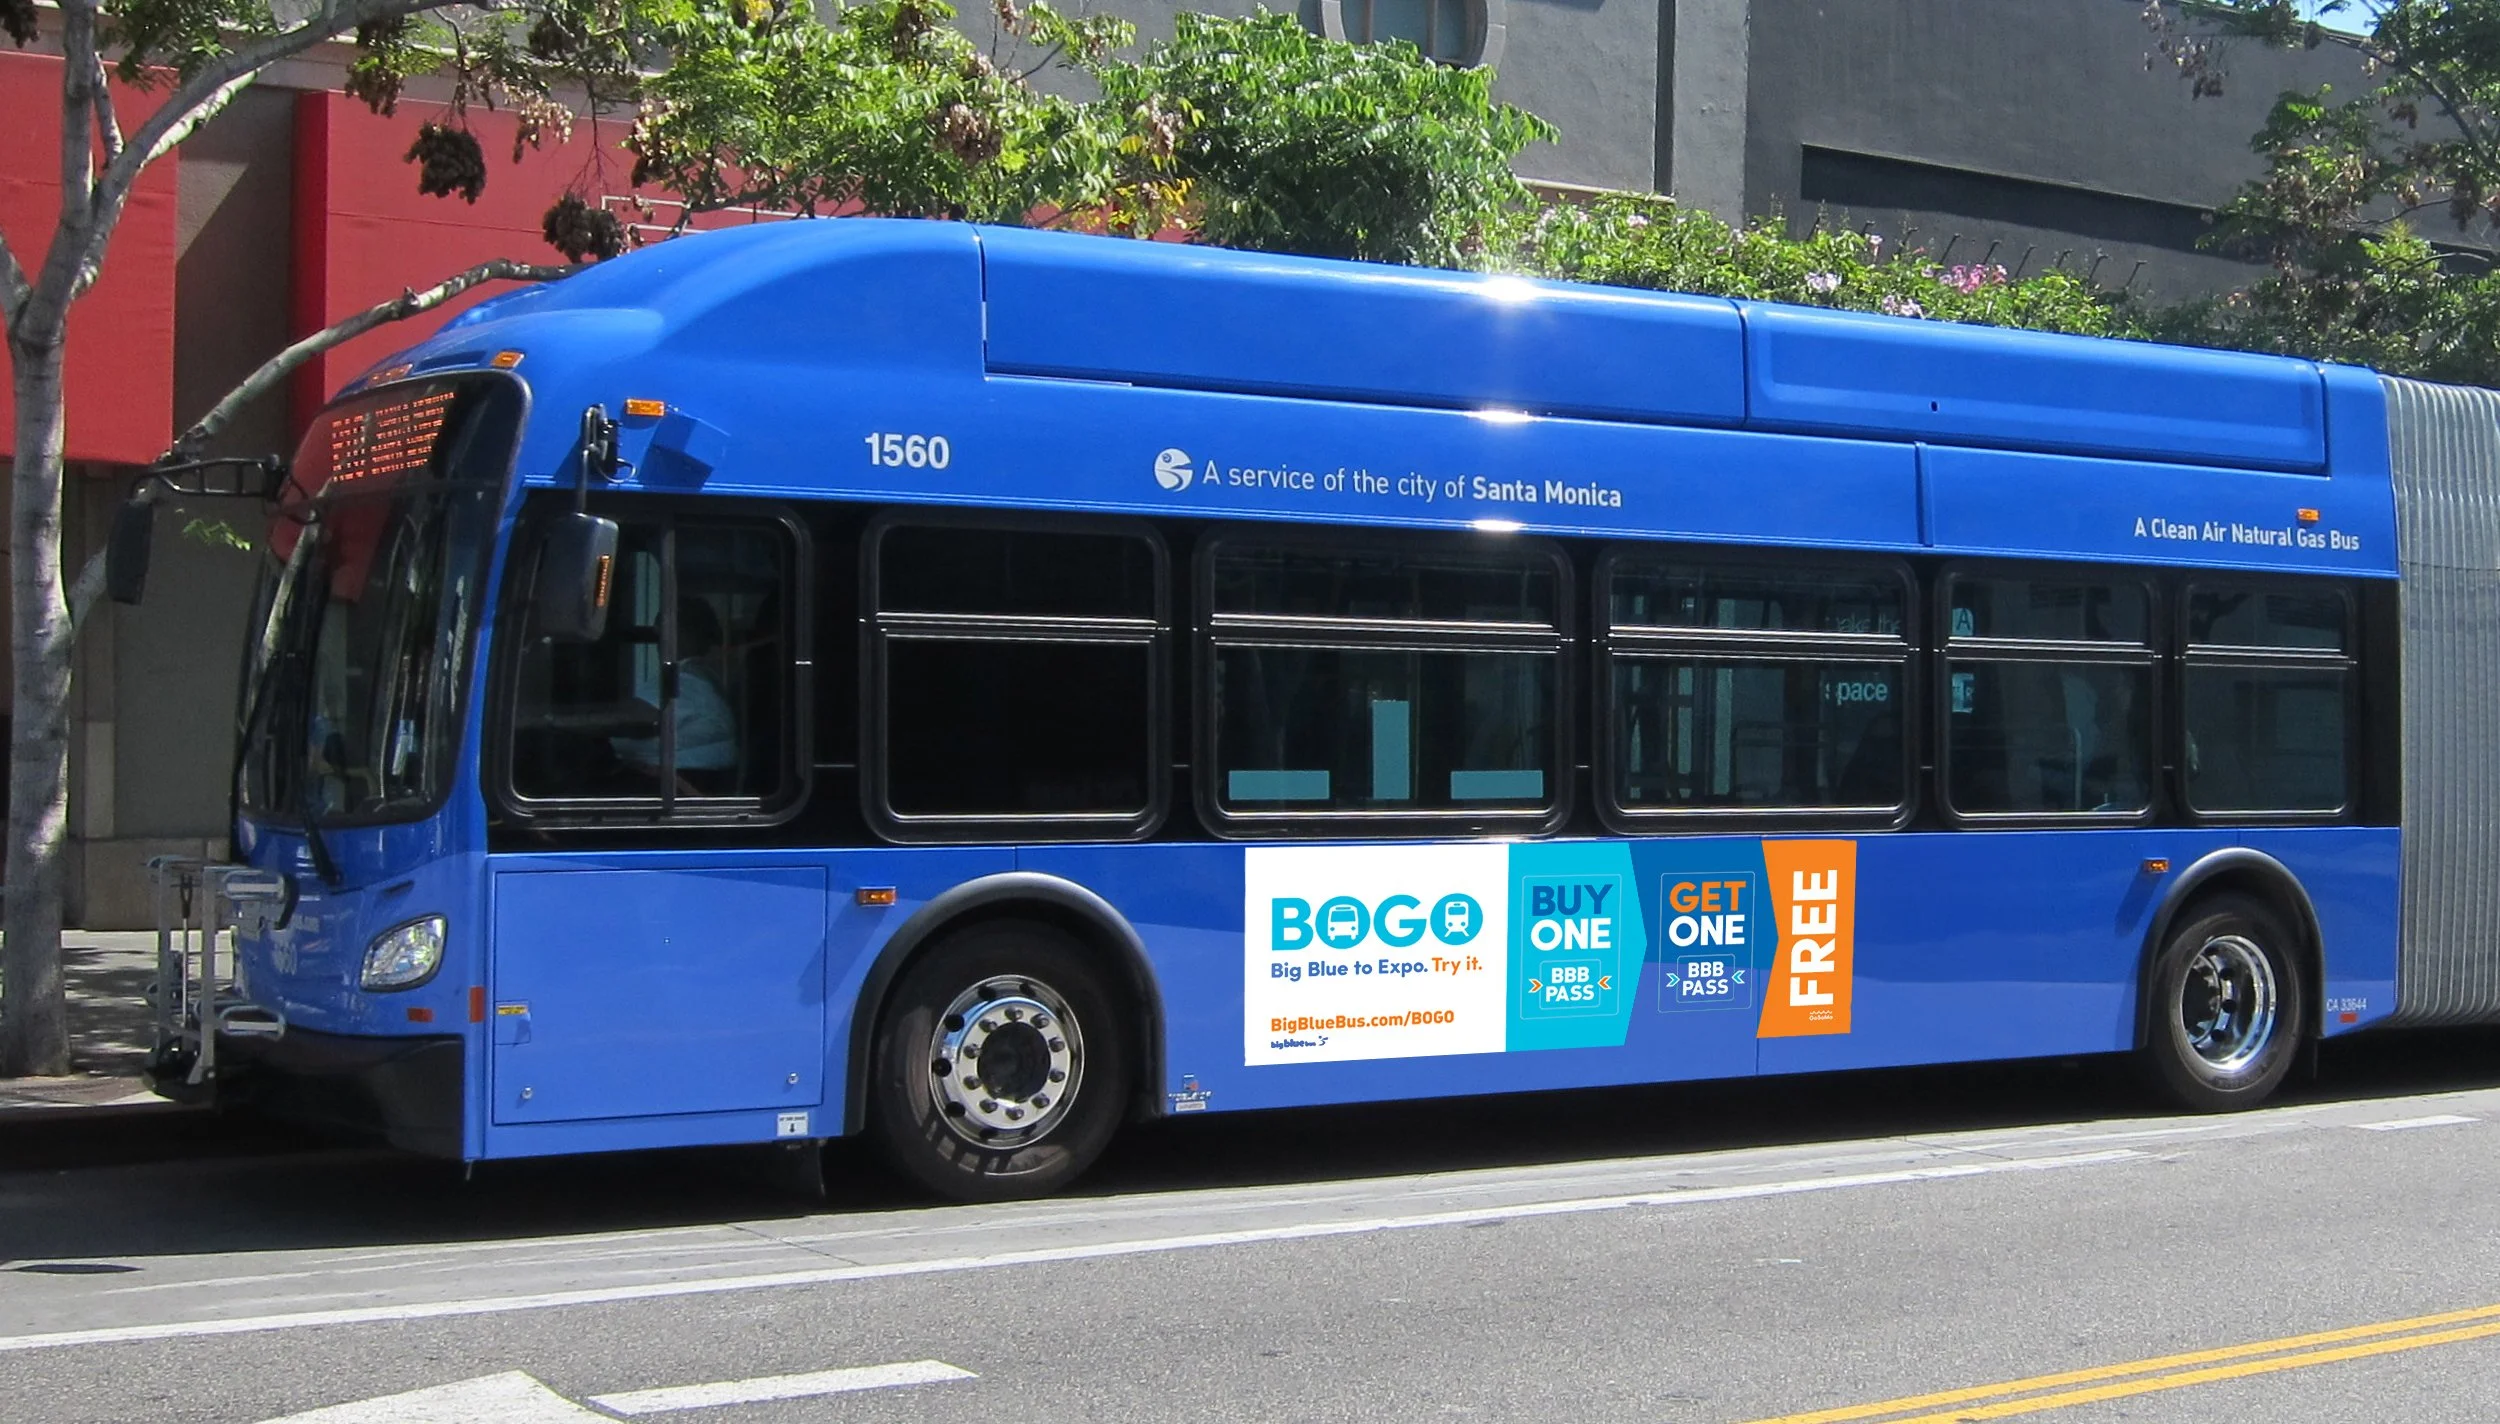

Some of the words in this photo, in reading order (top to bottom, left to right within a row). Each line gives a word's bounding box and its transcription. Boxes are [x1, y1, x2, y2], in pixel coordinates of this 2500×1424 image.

[864, 432, 950, 469] 1560
[1202, 460, 1221, 485] A
[1228, 464, 1315, 490] service
[1323, 468, 1345, 492] of
[1353, 469, 1389, 494] the
[1397, 472, 1437, 503] city
[1445, 474, 1465, 499] of
[1472, 476, 1537, 503] Santa
[1545, 480, 1622, 507] Monica
[2134, 517, 2147, 537] A
[2151, 518, 2197, 541] Clean
[2202, 521, 2226, 543] Air
[2231, 523, 2293, 547] Natural
[2297, 528, 2326, 549] Gas
[2331, 530, 2360, 550] Bus
[1532, 884, 1613, 916] BUY
[1669, 881, 1746, 913] GET
[1272, 893, 1483, 950] BOGO
[1530, 918, 1612, 951] ONE
[1668, 914, 1745, 947] ONE
[1789, 869, 1838, 1007] FREE
[1271, 962, 1301, 982] Big
[1308, 961, 1348, 977] Blue
[1354, 961, 1373, 975] to
[1379, 959, 1428, 977] Expo.
[1431, 957, 1461, 975] Try
[1465, 956, 1483, 971] it.
[1551, 966, 1590, 984] BBB
[1688, 961, 1724, 978] BBB
[1545, 984, 1595, 1003] PASS
[1682, 979, 1729, 996] PASS
[2326, 998, 2339, 1011] CA
[1271, 1010, 1455, 1034] BigBlueBus.com/BOGO
